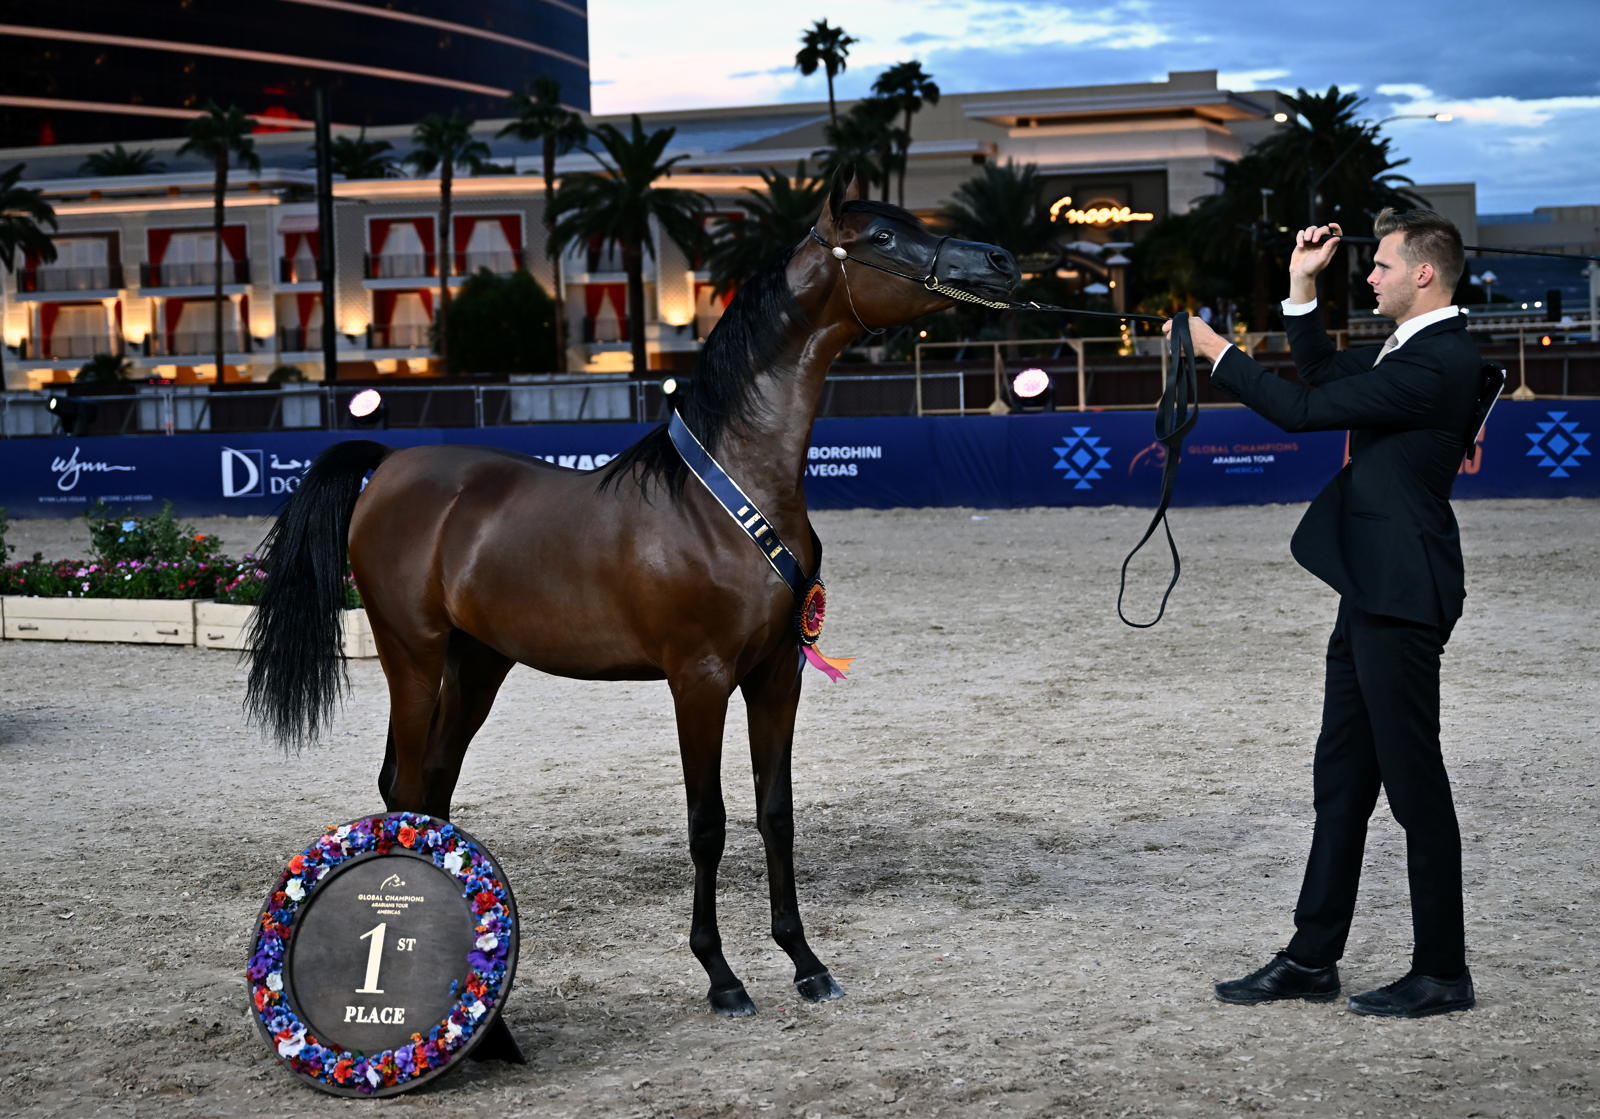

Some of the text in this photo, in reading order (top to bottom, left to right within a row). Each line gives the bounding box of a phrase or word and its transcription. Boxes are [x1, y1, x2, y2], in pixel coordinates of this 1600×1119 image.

[807, 446, 882, 459] BORGHINI
[1188, 442, 1299, 455] GLOBAL CHAMPIONS
[1212, 454, 1275, 464] ARABIANS TOUR
[808, 463, 858, 477] VEGAS
[1224, 465, 1264, 474] AMERICAS
[384, 894, 424, 903] CHAMPIONS
[343, 1005, 406, 1025] PLACE
